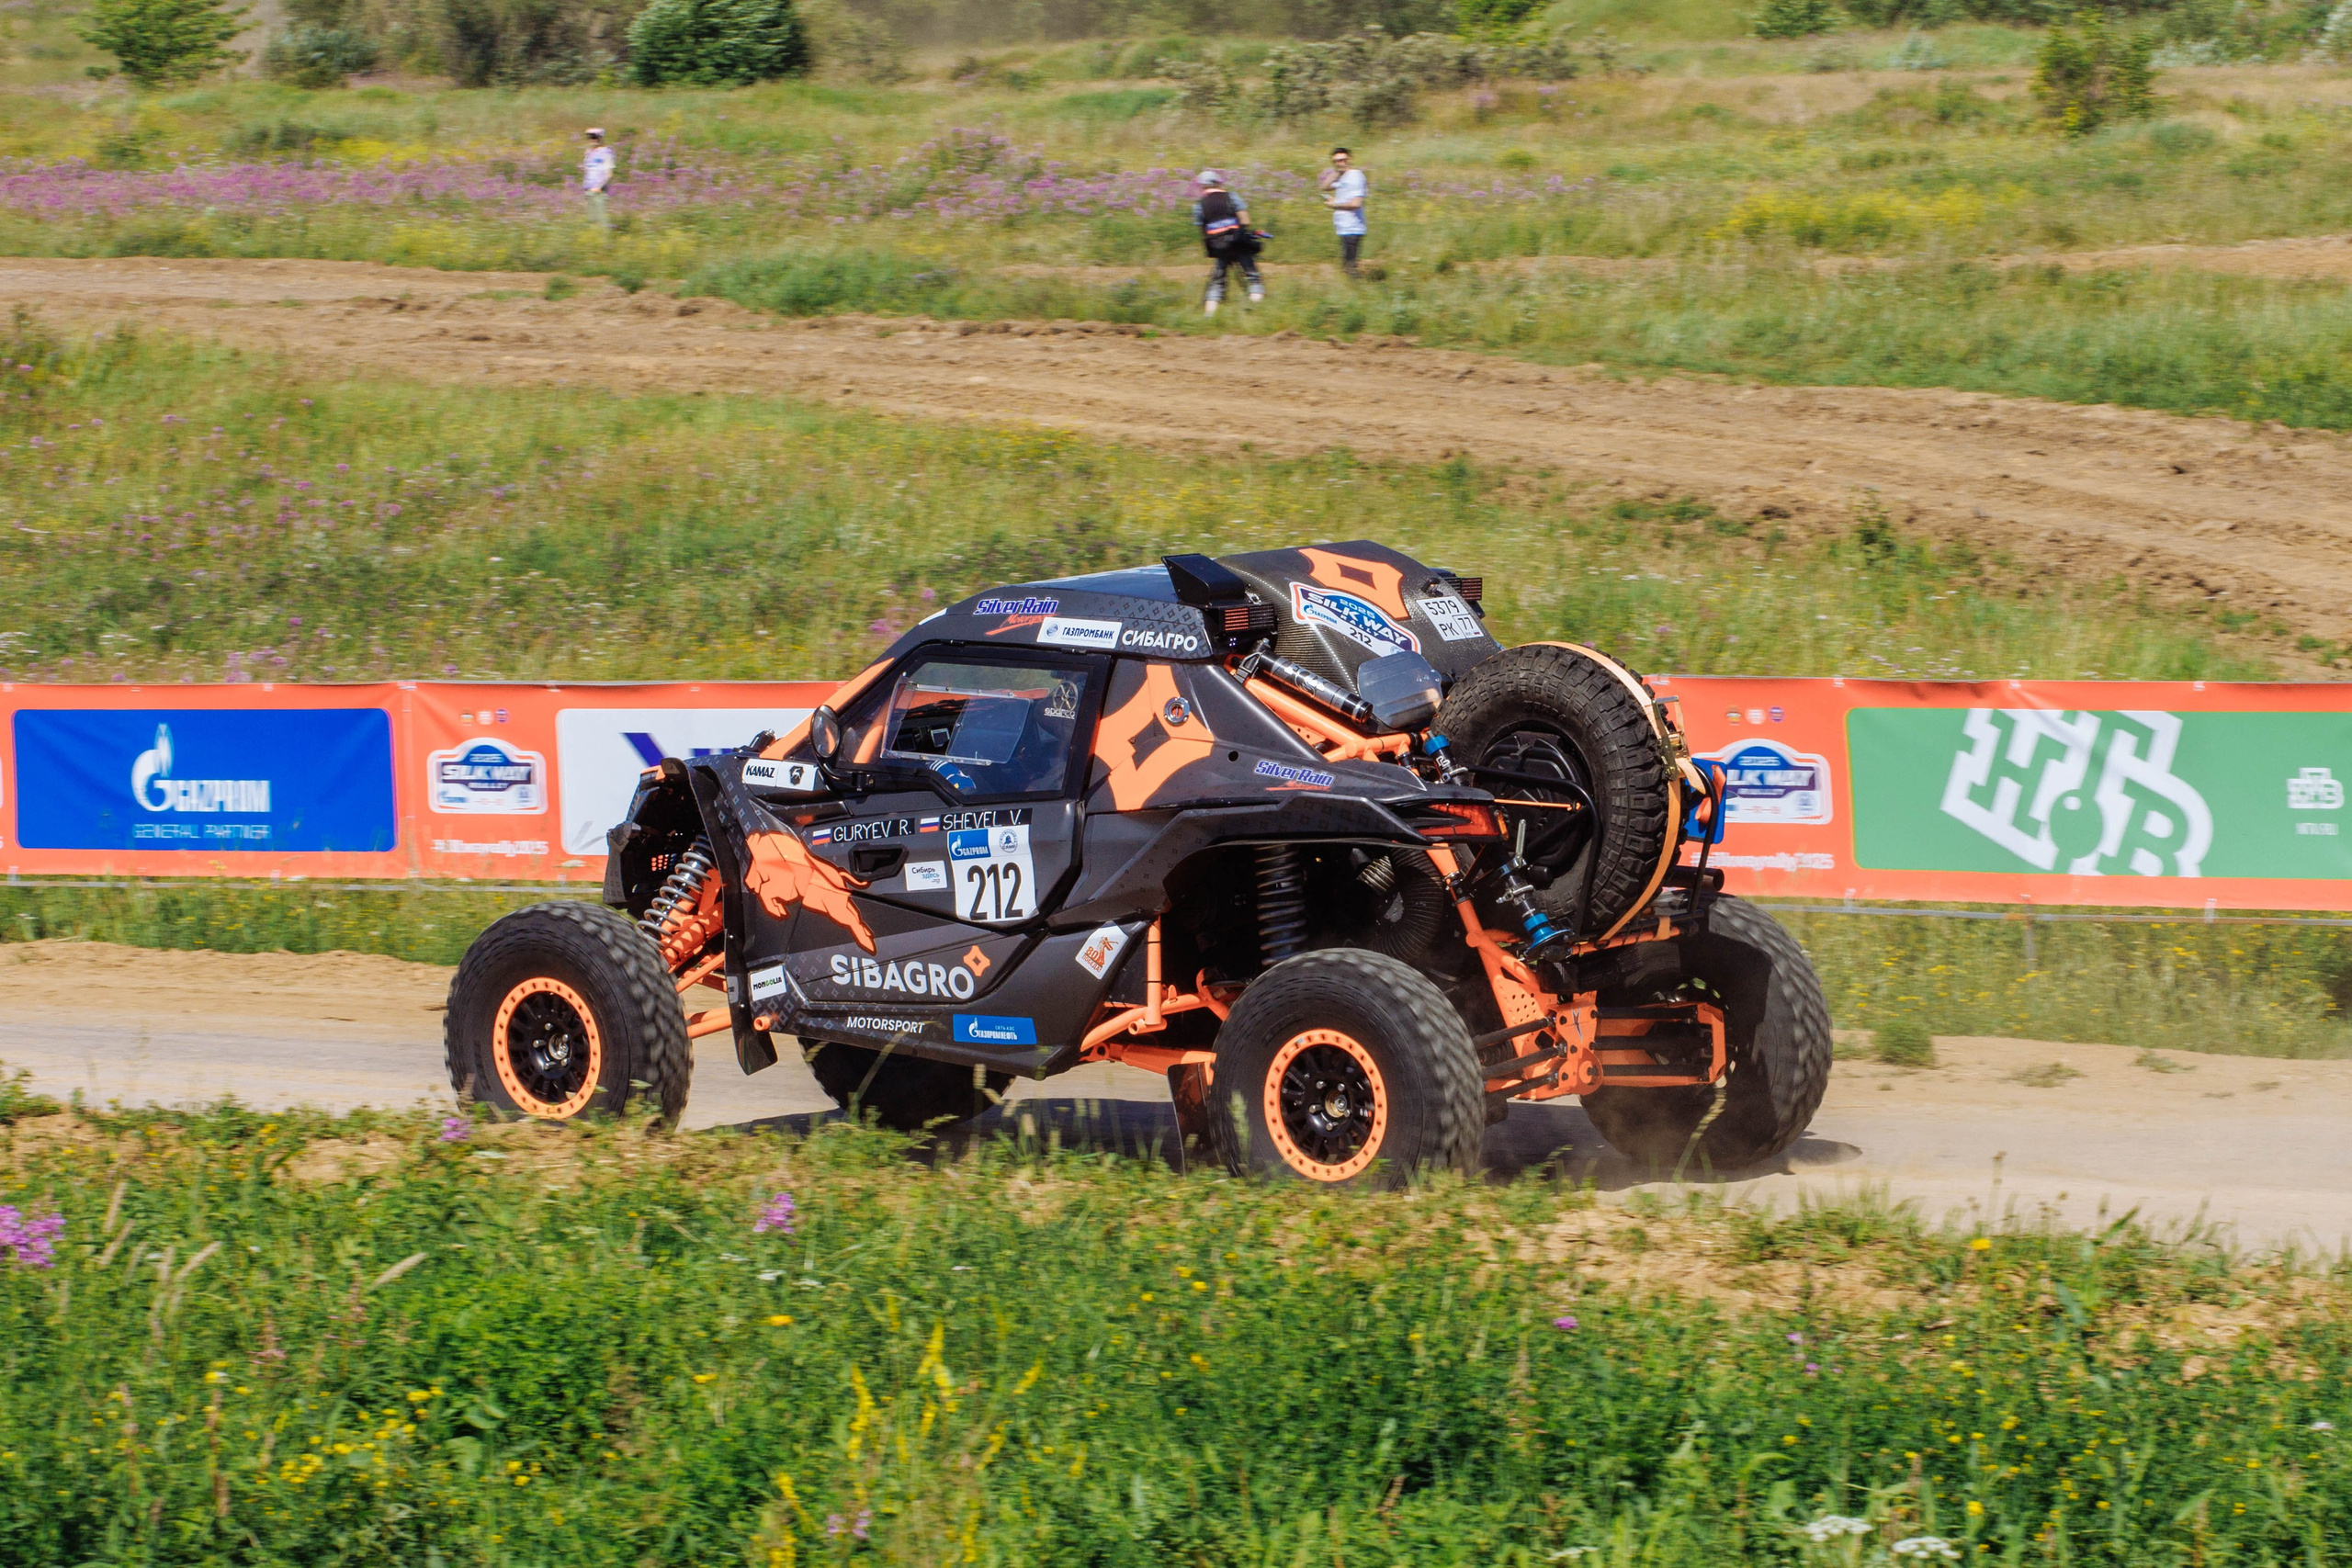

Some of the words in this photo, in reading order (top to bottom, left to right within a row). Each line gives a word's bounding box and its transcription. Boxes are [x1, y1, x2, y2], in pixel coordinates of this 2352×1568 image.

[1340, 598, 1375, 618] 2025
[1425, 600, 1460, 615] 5379
[1306, 592, 1361, 621] SILK
[1363, 615, 1408, 645] WAY
[1340, 615, 1379, 637] RALLY
[1457, 616, 1474, 630] 77
[1062, 626, 1115, 640] ГАЗПРОМБАНК
[1122, 629, 1198, 652] СИБАГРО
[1350, 626, 1373, 648] 212
[745, 765, 775, 779] KAMAZ
[943, 811, 1002, 830] SHEVEL
[1010, 809, 1022, 825] V.
[833, 820, 891, 841] GURYEV
[899, 819, 911, 835] R.
[967, 862, 1023, 921] 212
[1086, 945, 1099, 961] 80
[752, 976, 783, 990] MONGOLIA
[831, 953, 975, 999] SIBAGRO
[846, 1016, 925, 1034] MOTORSPORT
